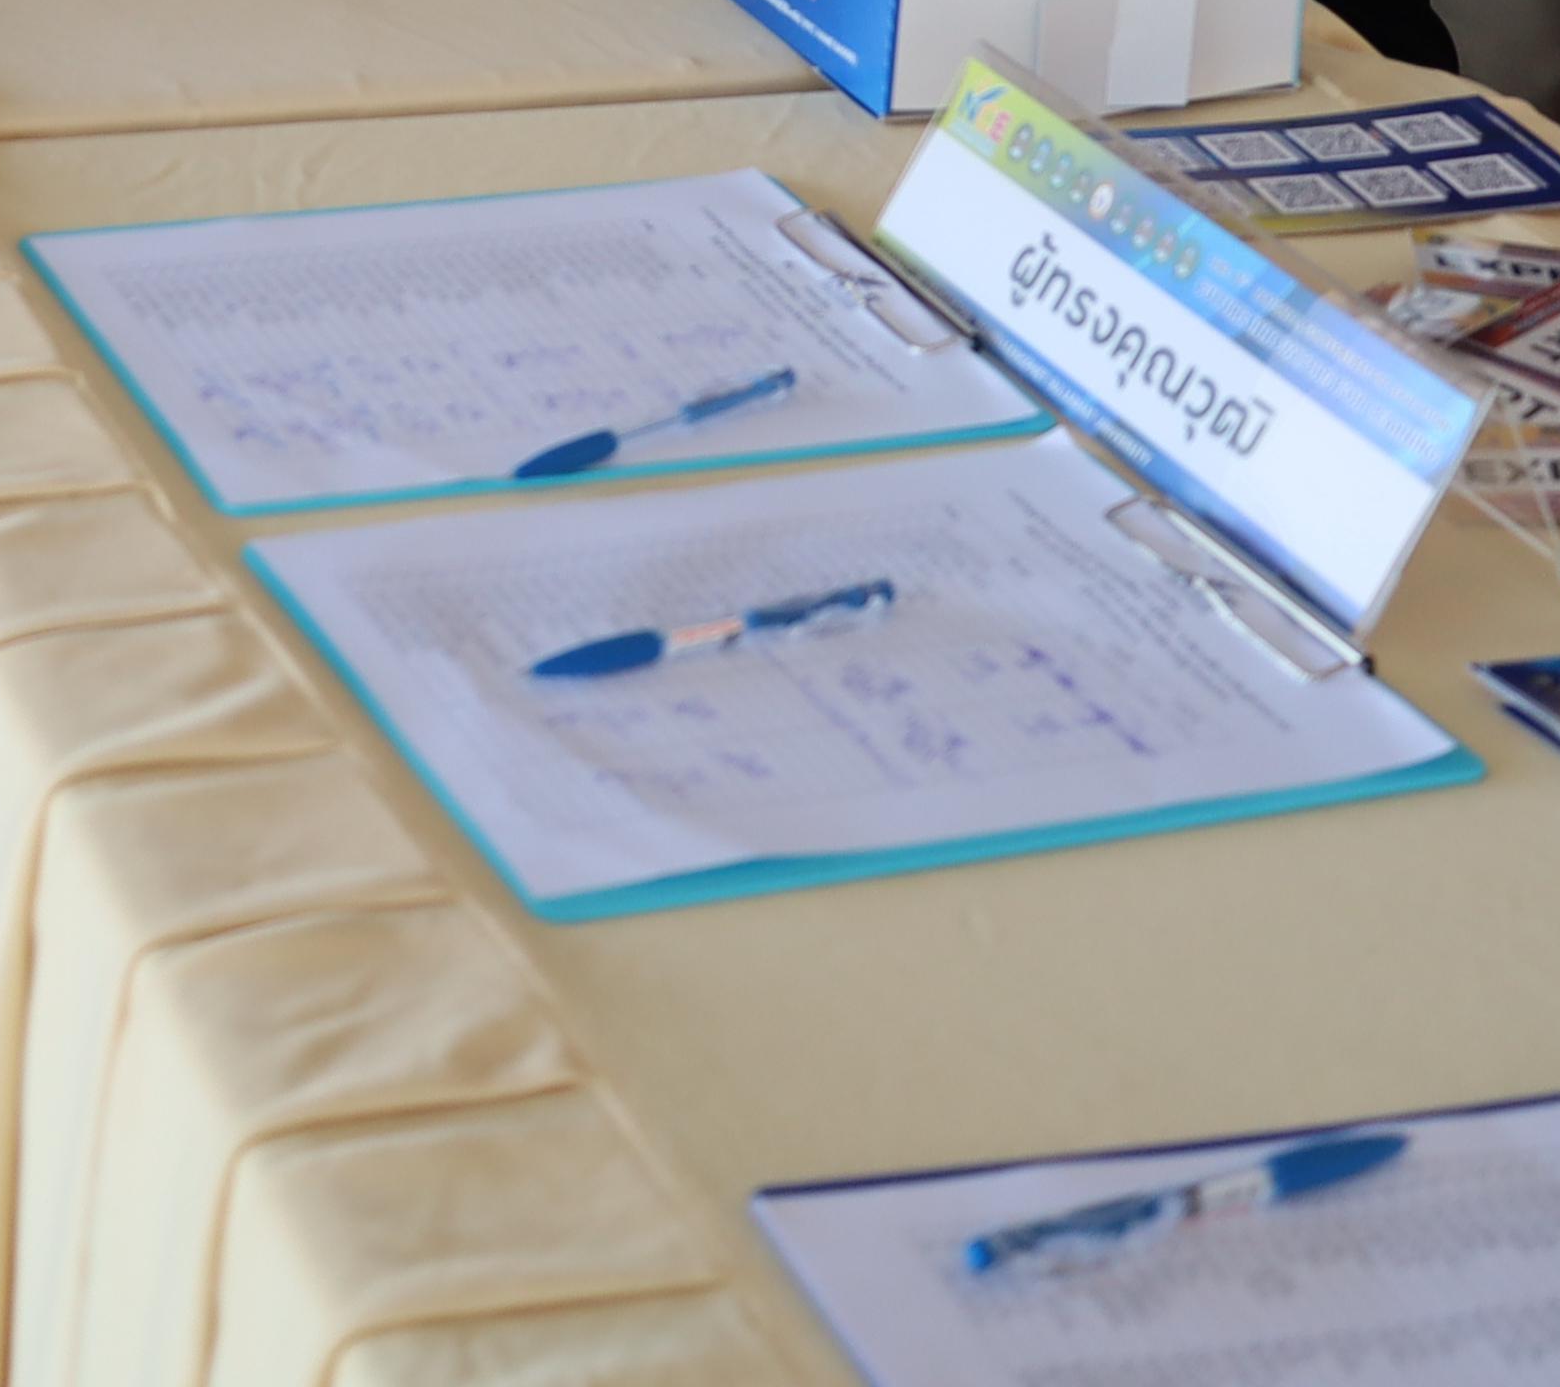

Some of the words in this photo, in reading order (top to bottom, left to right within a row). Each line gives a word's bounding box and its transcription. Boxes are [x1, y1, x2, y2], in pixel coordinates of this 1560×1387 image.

[1008, 233, 1277, 463] ผู้ทรงคุณวุฒิ
